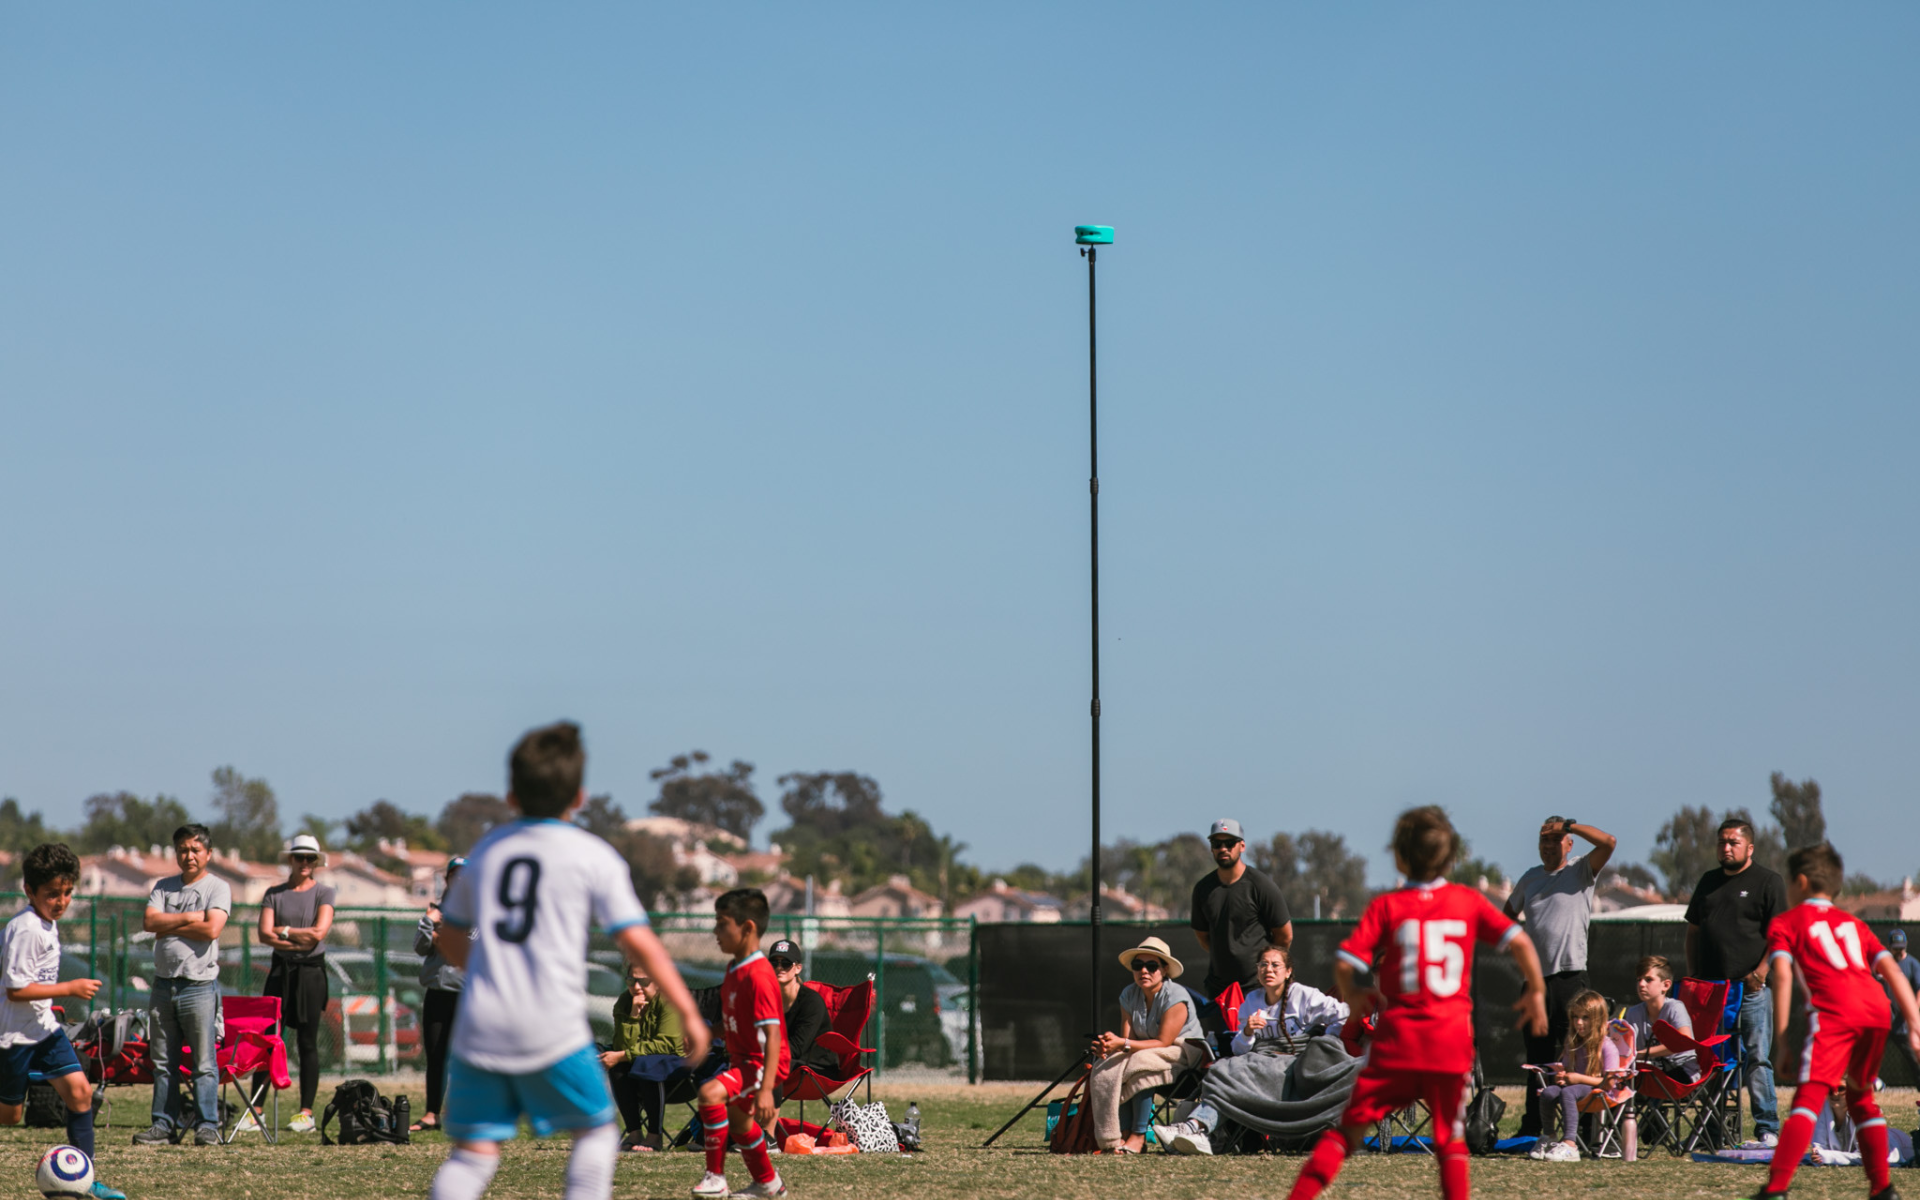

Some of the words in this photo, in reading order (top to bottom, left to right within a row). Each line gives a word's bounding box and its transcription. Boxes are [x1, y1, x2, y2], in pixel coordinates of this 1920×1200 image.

[495, 856, 542, 945] 9
[1395, 918, 1467, 997] 15
[1808, 920, 1867, 970] 11
